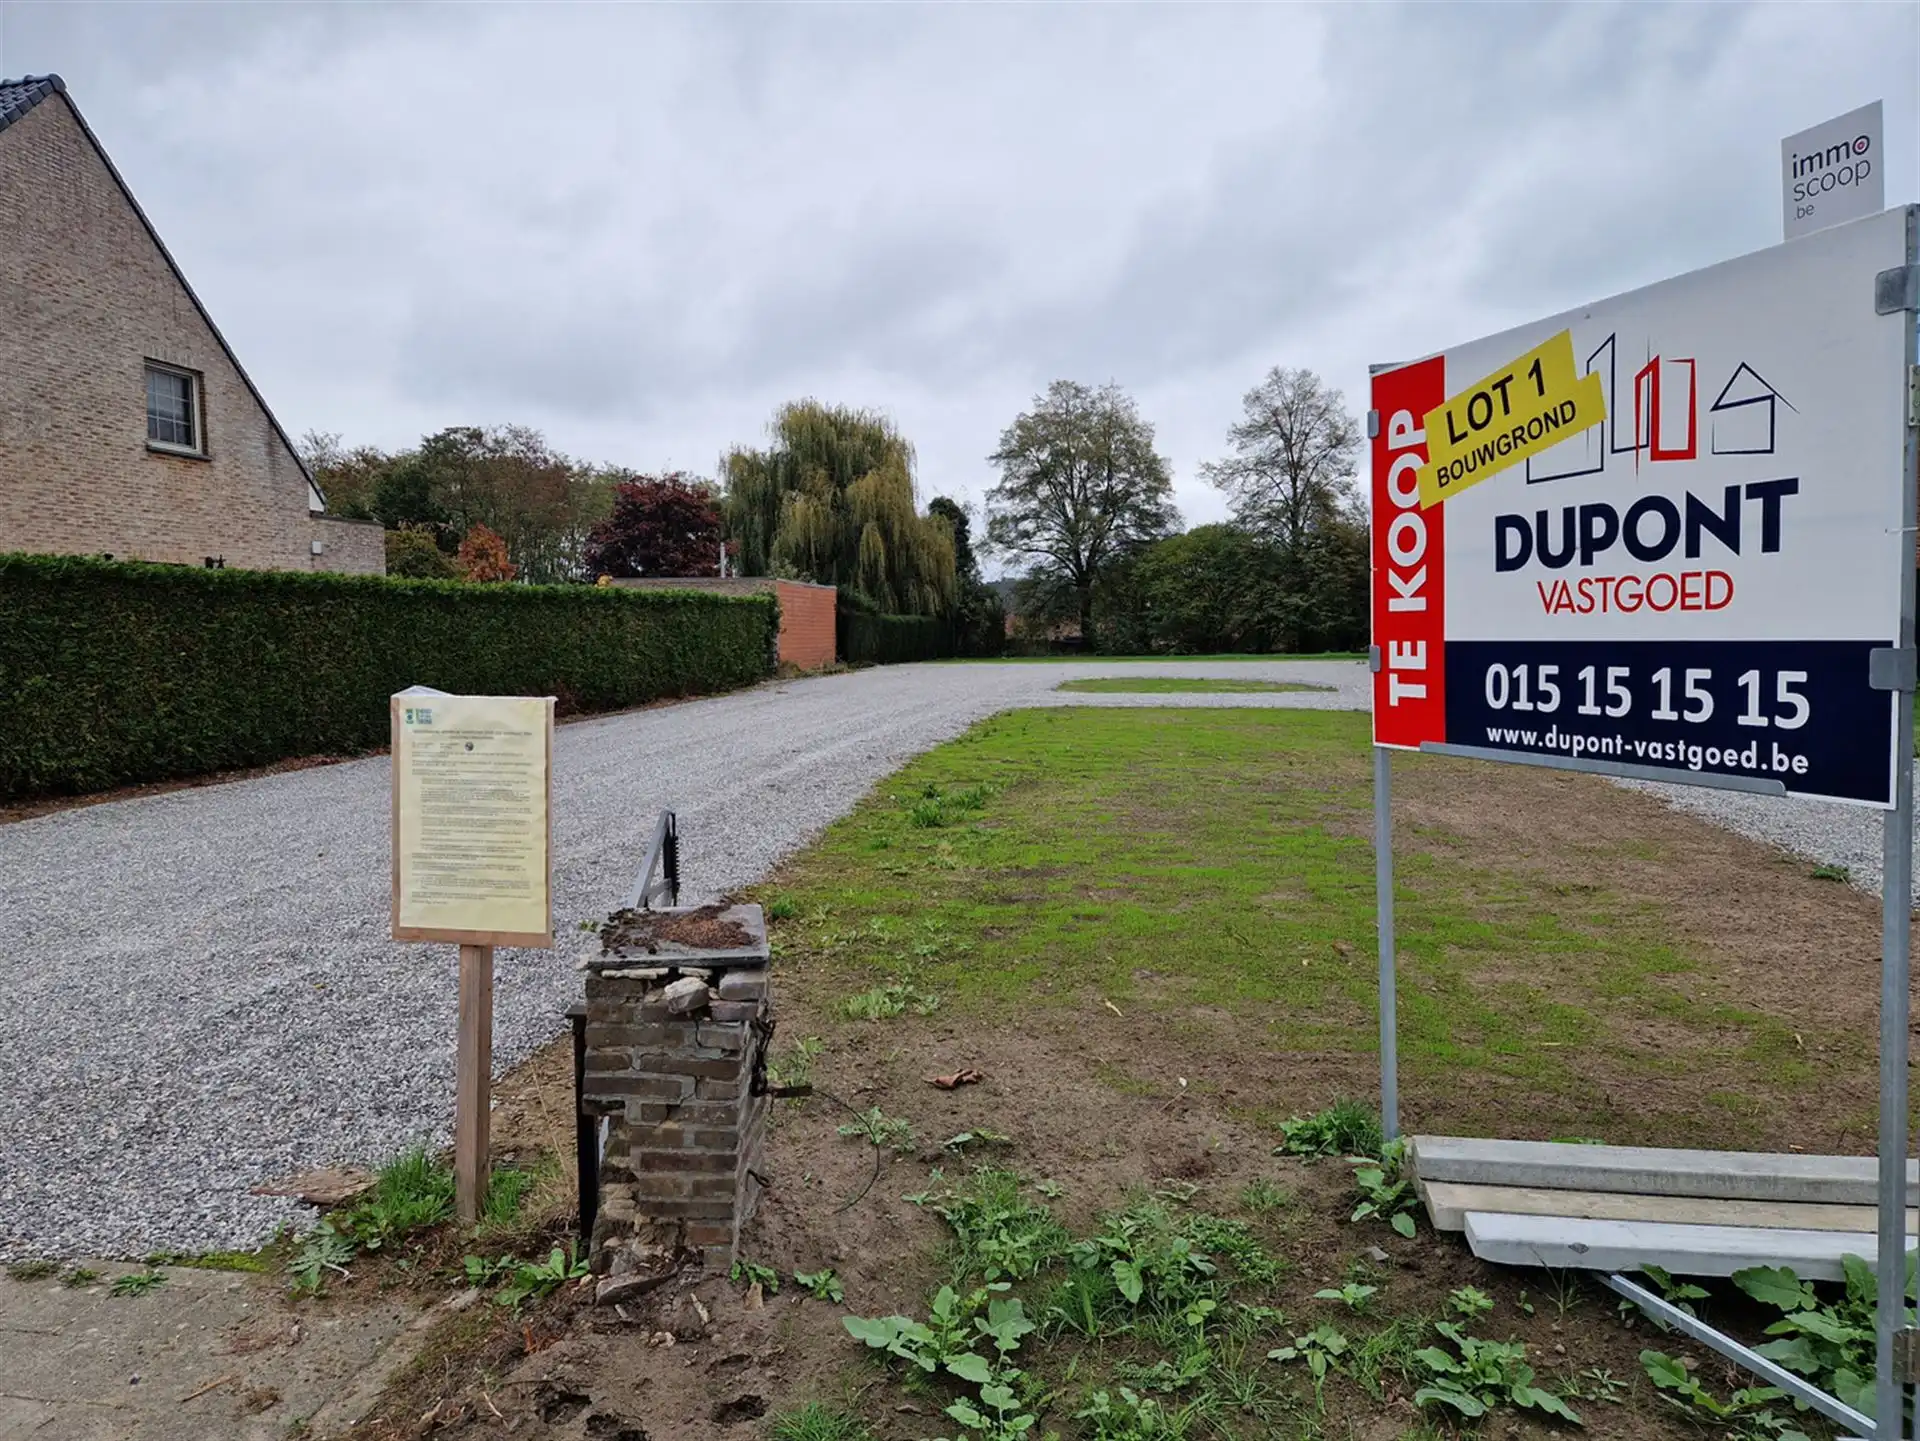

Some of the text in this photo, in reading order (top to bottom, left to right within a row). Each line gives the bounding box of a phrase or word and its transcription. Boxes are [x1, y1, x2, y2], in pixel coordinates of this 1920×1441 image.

[1792, 134, 1870, 180] immo
[1793, 160, 1871, 202] scoop
[1793, 204, 1815, 221] .be
[1446, 357, 1546, 446] LOT 1
[1436, 399, 1577, 489] BOUWGROND
[1494, 477, 1799, 573] DUPONT
[1387, 408, 1428, 707] TE KOOP
[1536, 570, 1735, 615] VASTGOED
[1484, 662, 1811, 730] 015 15 15 15
[1486, 724, 1810, 775] www.dupont-vastgoed.be
